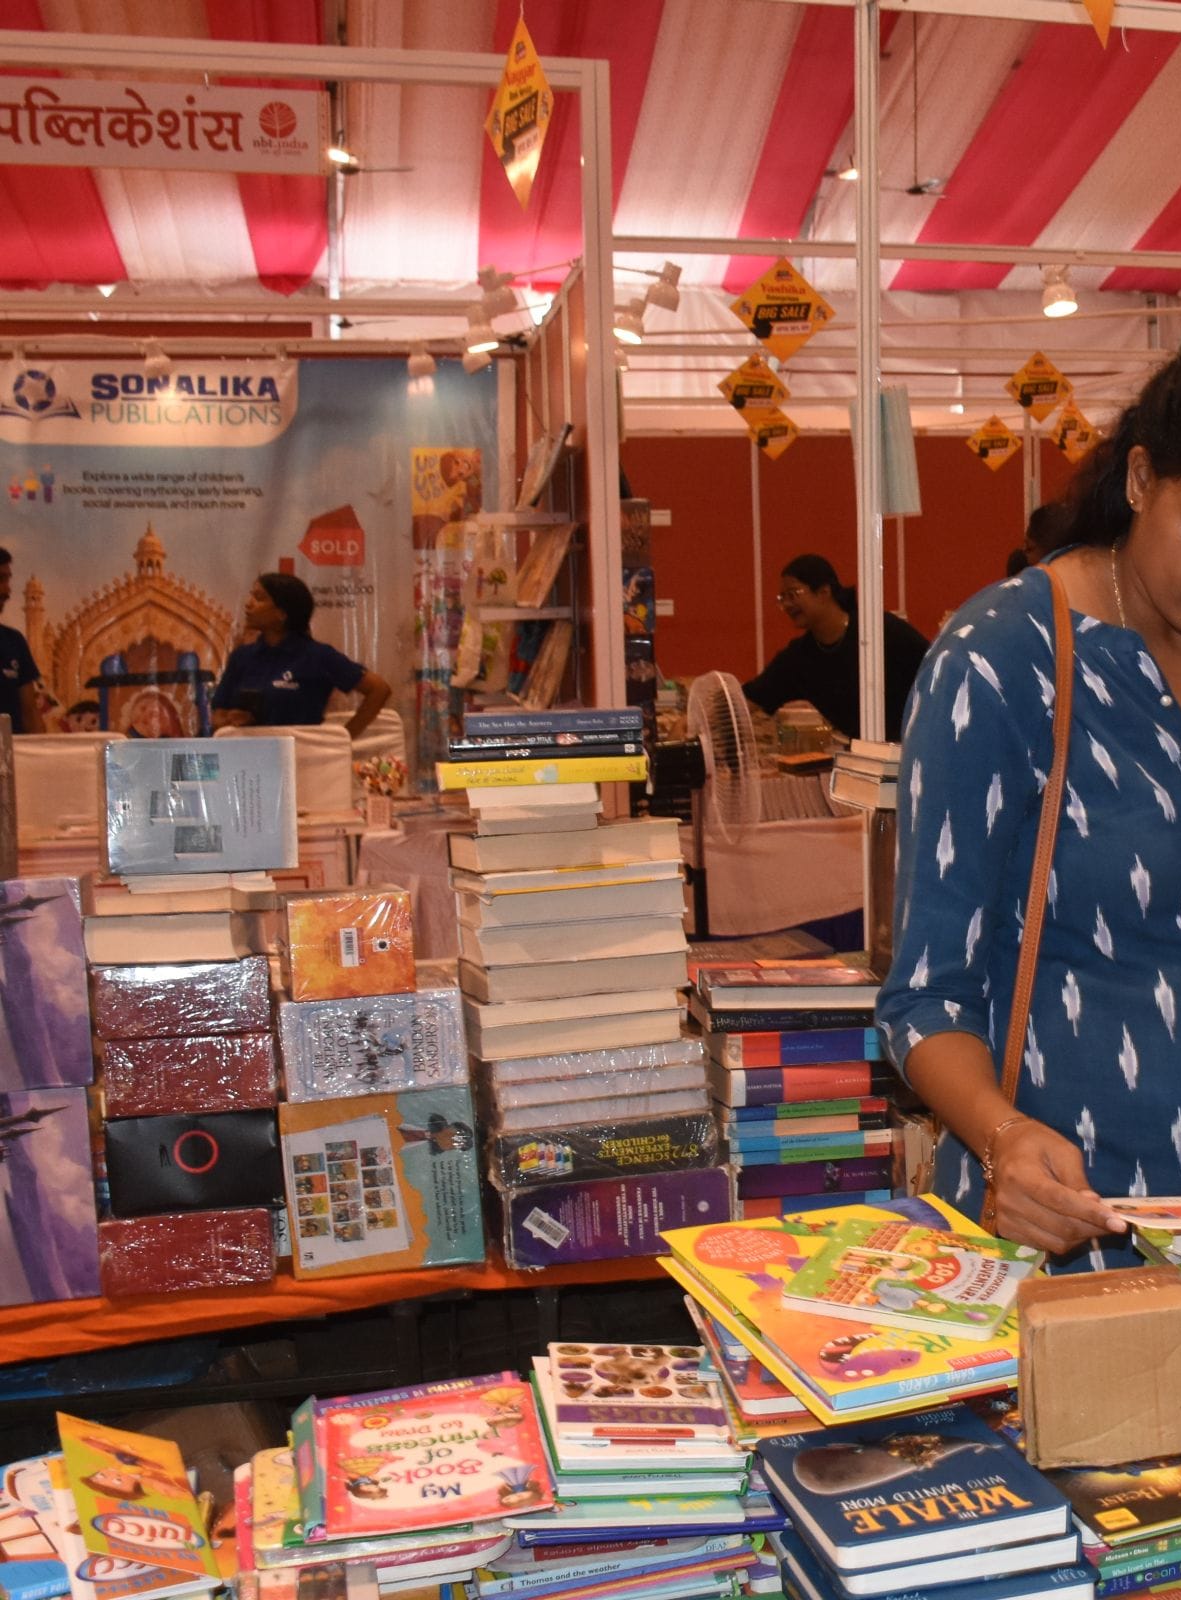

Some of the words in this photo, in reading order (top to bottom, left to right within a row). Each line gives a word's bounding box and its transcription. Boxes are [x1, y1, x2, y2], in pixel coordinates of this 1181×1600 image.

[758, 306, 777, 319] BIG
[780, 304, 806, 318] SALE
[91, 374, 280, 401] SONALIKA
[90, 402, 282, 425] PUBLICATIONS
[83, 471, 121, 483] Explore
[131, 471, 154, 482] wide
[157, 473, 185, 484] range
[187, 471, 197, 482] of
[97, 486, 141, 498] covering
[197, 485, 221, 498] early
[83, 499, 110, 509] social
[170, 499, 189, 509] and
[190, 499, 219, 509] much
[310, 540, 360, 556] SOLD
[601, 1135, 655, 1149] CHILDREN
[656, 1134, 670, 1142] for
[597, 1144, 670, 1158] EXPERIMENTS
[616, 1151, 670, 1165] SCIENCE
[671, 1144, 698, 1159] 872
[929, 1262, 955, 1285] ZOO
[955, 1258, 996, 1302] ADVENTURE
[978, 1268, 1008, 1300] ZOOKEEPER
[899, 1371, 940, 1392] CARDS
[947, 1368, 976, 1384] GAME
[379, 1423, 432, 1437] Draw
[367, 1427, 501, 1454] Princess
[417, 1447, 453, 1466] of
[395, 1458, 483, 1485] Book
[421, 1482, 462, 1498] My
[901, 1481, 962, 1502] WANTED
[964, 1474, 1007, 1492] WHO
[840, 1491, 896, 1511] MORE
[1096, 1486, 1165, 1508] Beast
[843, 1486, 1033, 1534] WHALE
[520, 1573, 554, 1587] Thomas
[556, 1571, 571, 1584] and
[573, 1567, 587, 1582] the
[588, 1563, 620, 1580] weather
